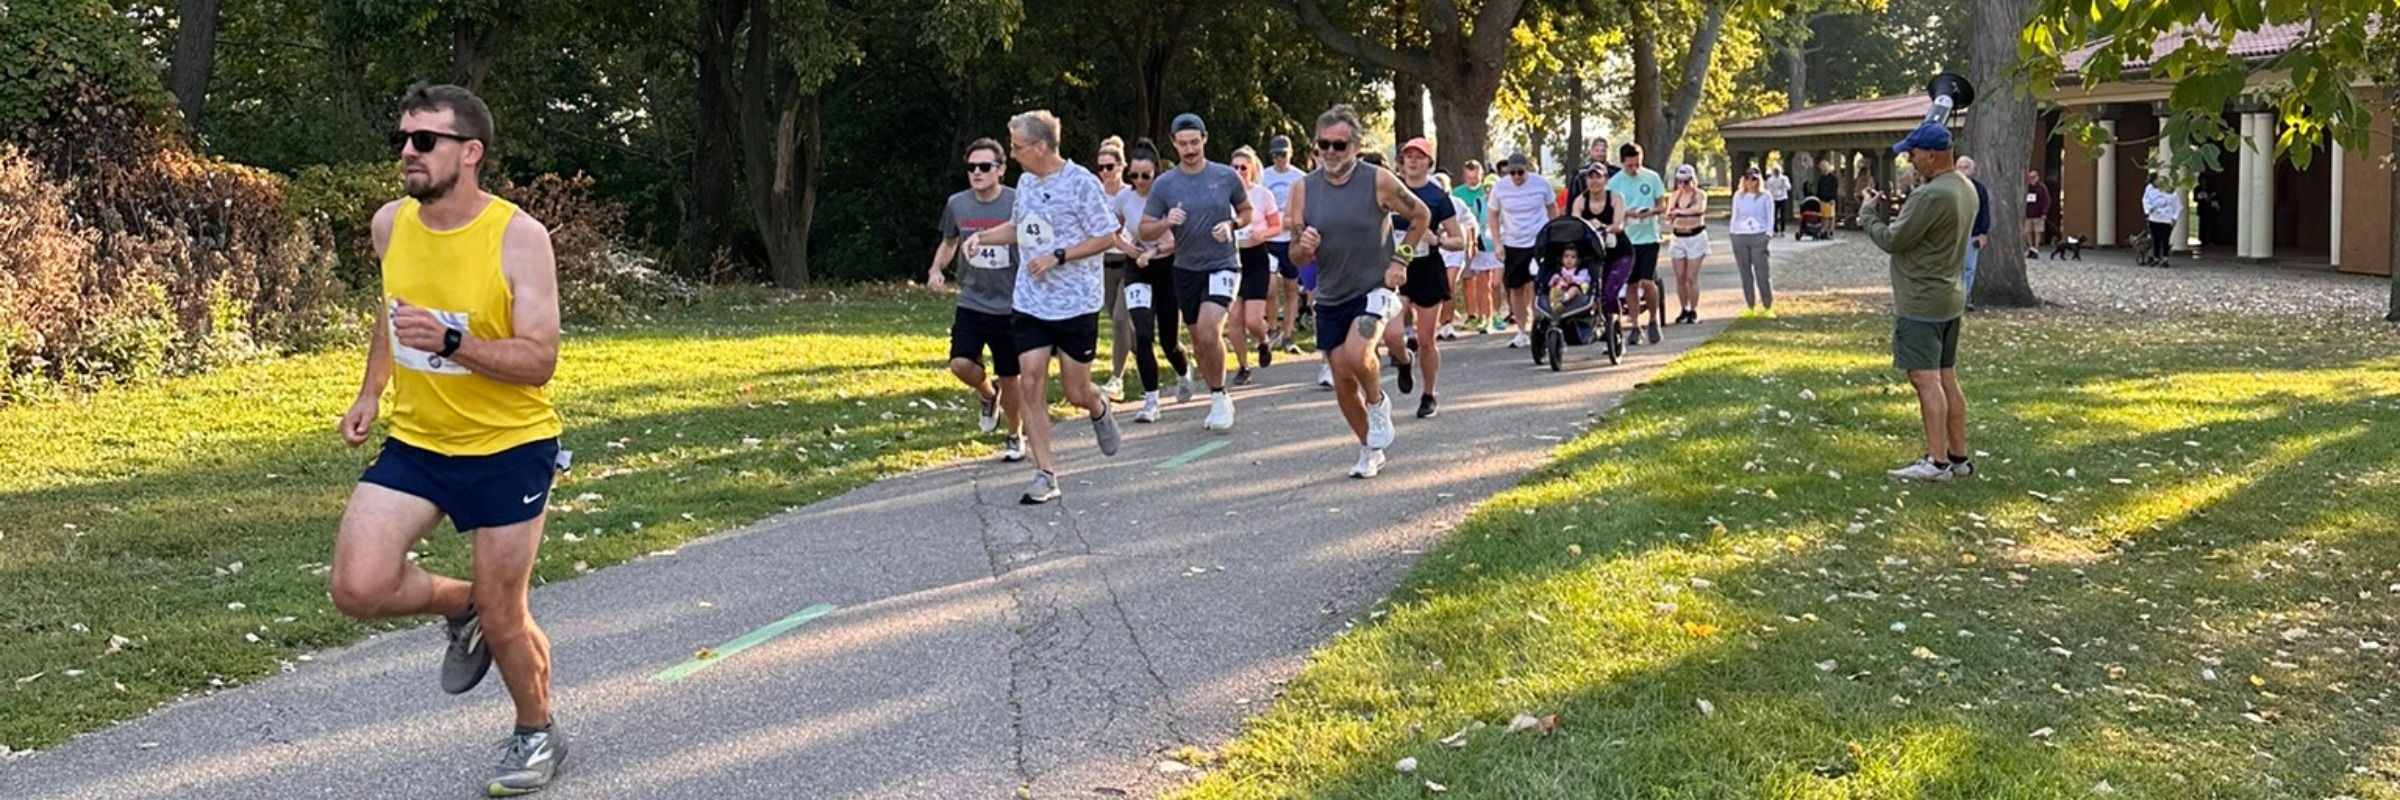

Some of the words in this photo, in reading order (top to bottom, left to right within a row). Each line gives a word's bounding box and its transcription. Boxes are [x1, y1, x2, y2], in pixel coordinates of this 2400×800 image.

[1026, 223, 1041, 236] 43
[981, 248, 996, 258] 44
[1129, 289, 1141, 300] 17
